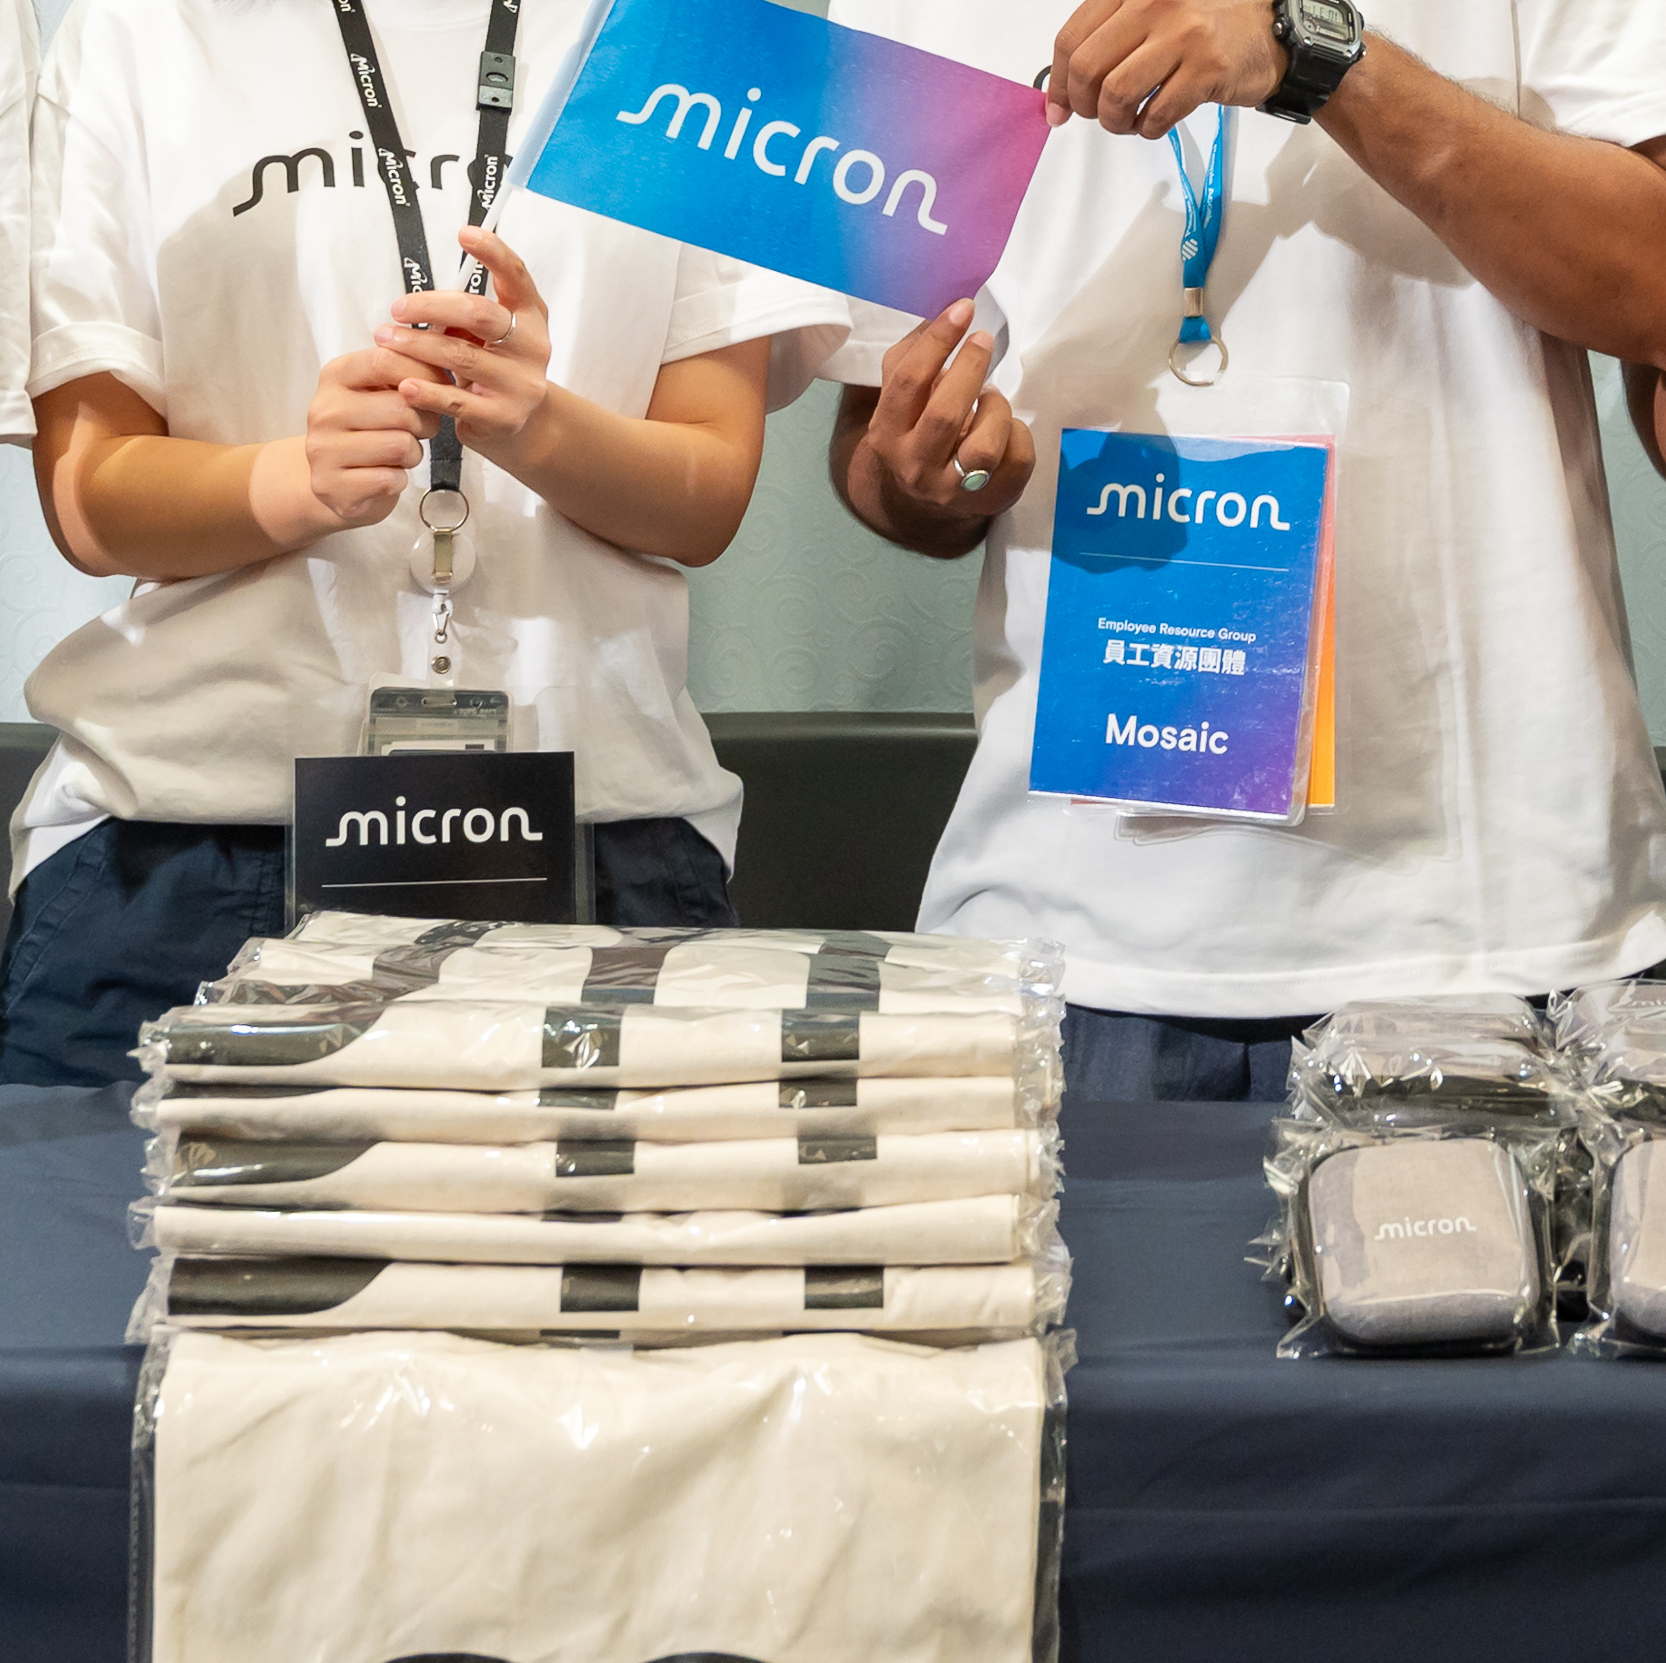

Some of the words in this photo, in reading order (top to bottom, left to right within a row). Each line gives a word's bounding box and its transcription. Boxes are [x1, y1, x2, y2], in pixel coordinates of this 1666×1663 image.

[350, 52, 383, 108] Micron
[377, 146, 411, 208] Micron
[477, 154, 499, 211] Micron
[615, 83, 949, 236] micron
[1086, 472, 1291, 532] micron
[1097, 616, 1157, 635] Employee
[1159, 621, 1216, 641] Resource
[1217, 625, 1258, 644] Group
[1102, 638, 1248, 677] 員工資源團體
[1104, 712, 1230, 755] Mosaic
[324, 794, 544, 848] micron
[1373, 1216, 1476, 1242] micron
